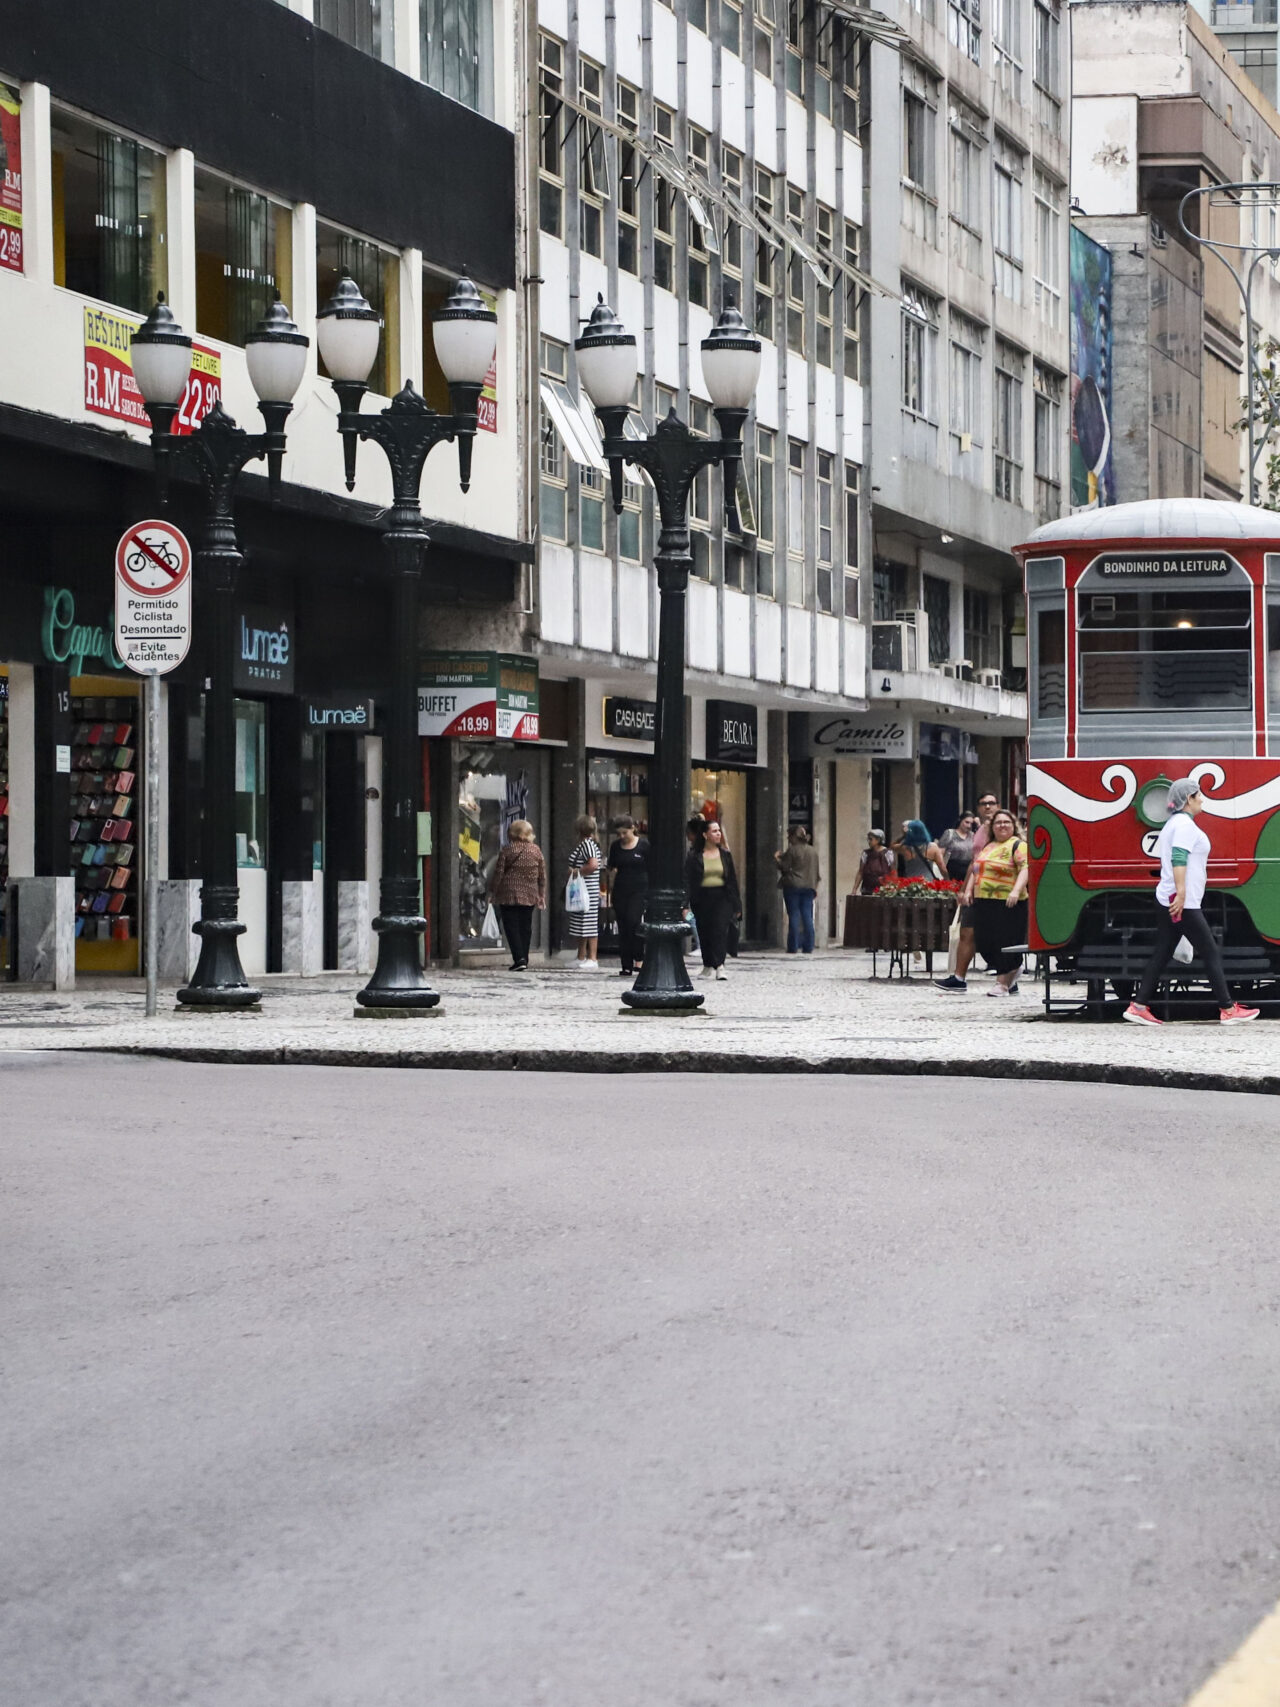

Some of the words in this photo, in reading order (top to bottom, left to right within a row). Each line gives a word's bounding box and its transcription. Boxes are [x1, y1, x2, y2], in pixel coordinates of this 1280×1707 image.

[86, 361, 121, 412] R.M
[1104, 561, 1160, 573] BONDINHO
[1163, 561, 1178, 572] DA
[1180, 560, 1227, 572] LEITURA
[128, 600, 179, 609] Permitido
[133, 612, 173, 621] Ciclista
[120, 625, 187, 634] Desmontado
[140, 642, 166, 651] Evite
[127, 652, 180, 661] Acidentes
[248, 666, 281, 680] PRATAS
[449, 675, 473, 683] MARTINI
[58, 691, 69, 713] 15
[418, 696, 457, 712] BUFFET
[615, 709, 636, 727] CASA
[814, 718, 905, 745] Camilo
